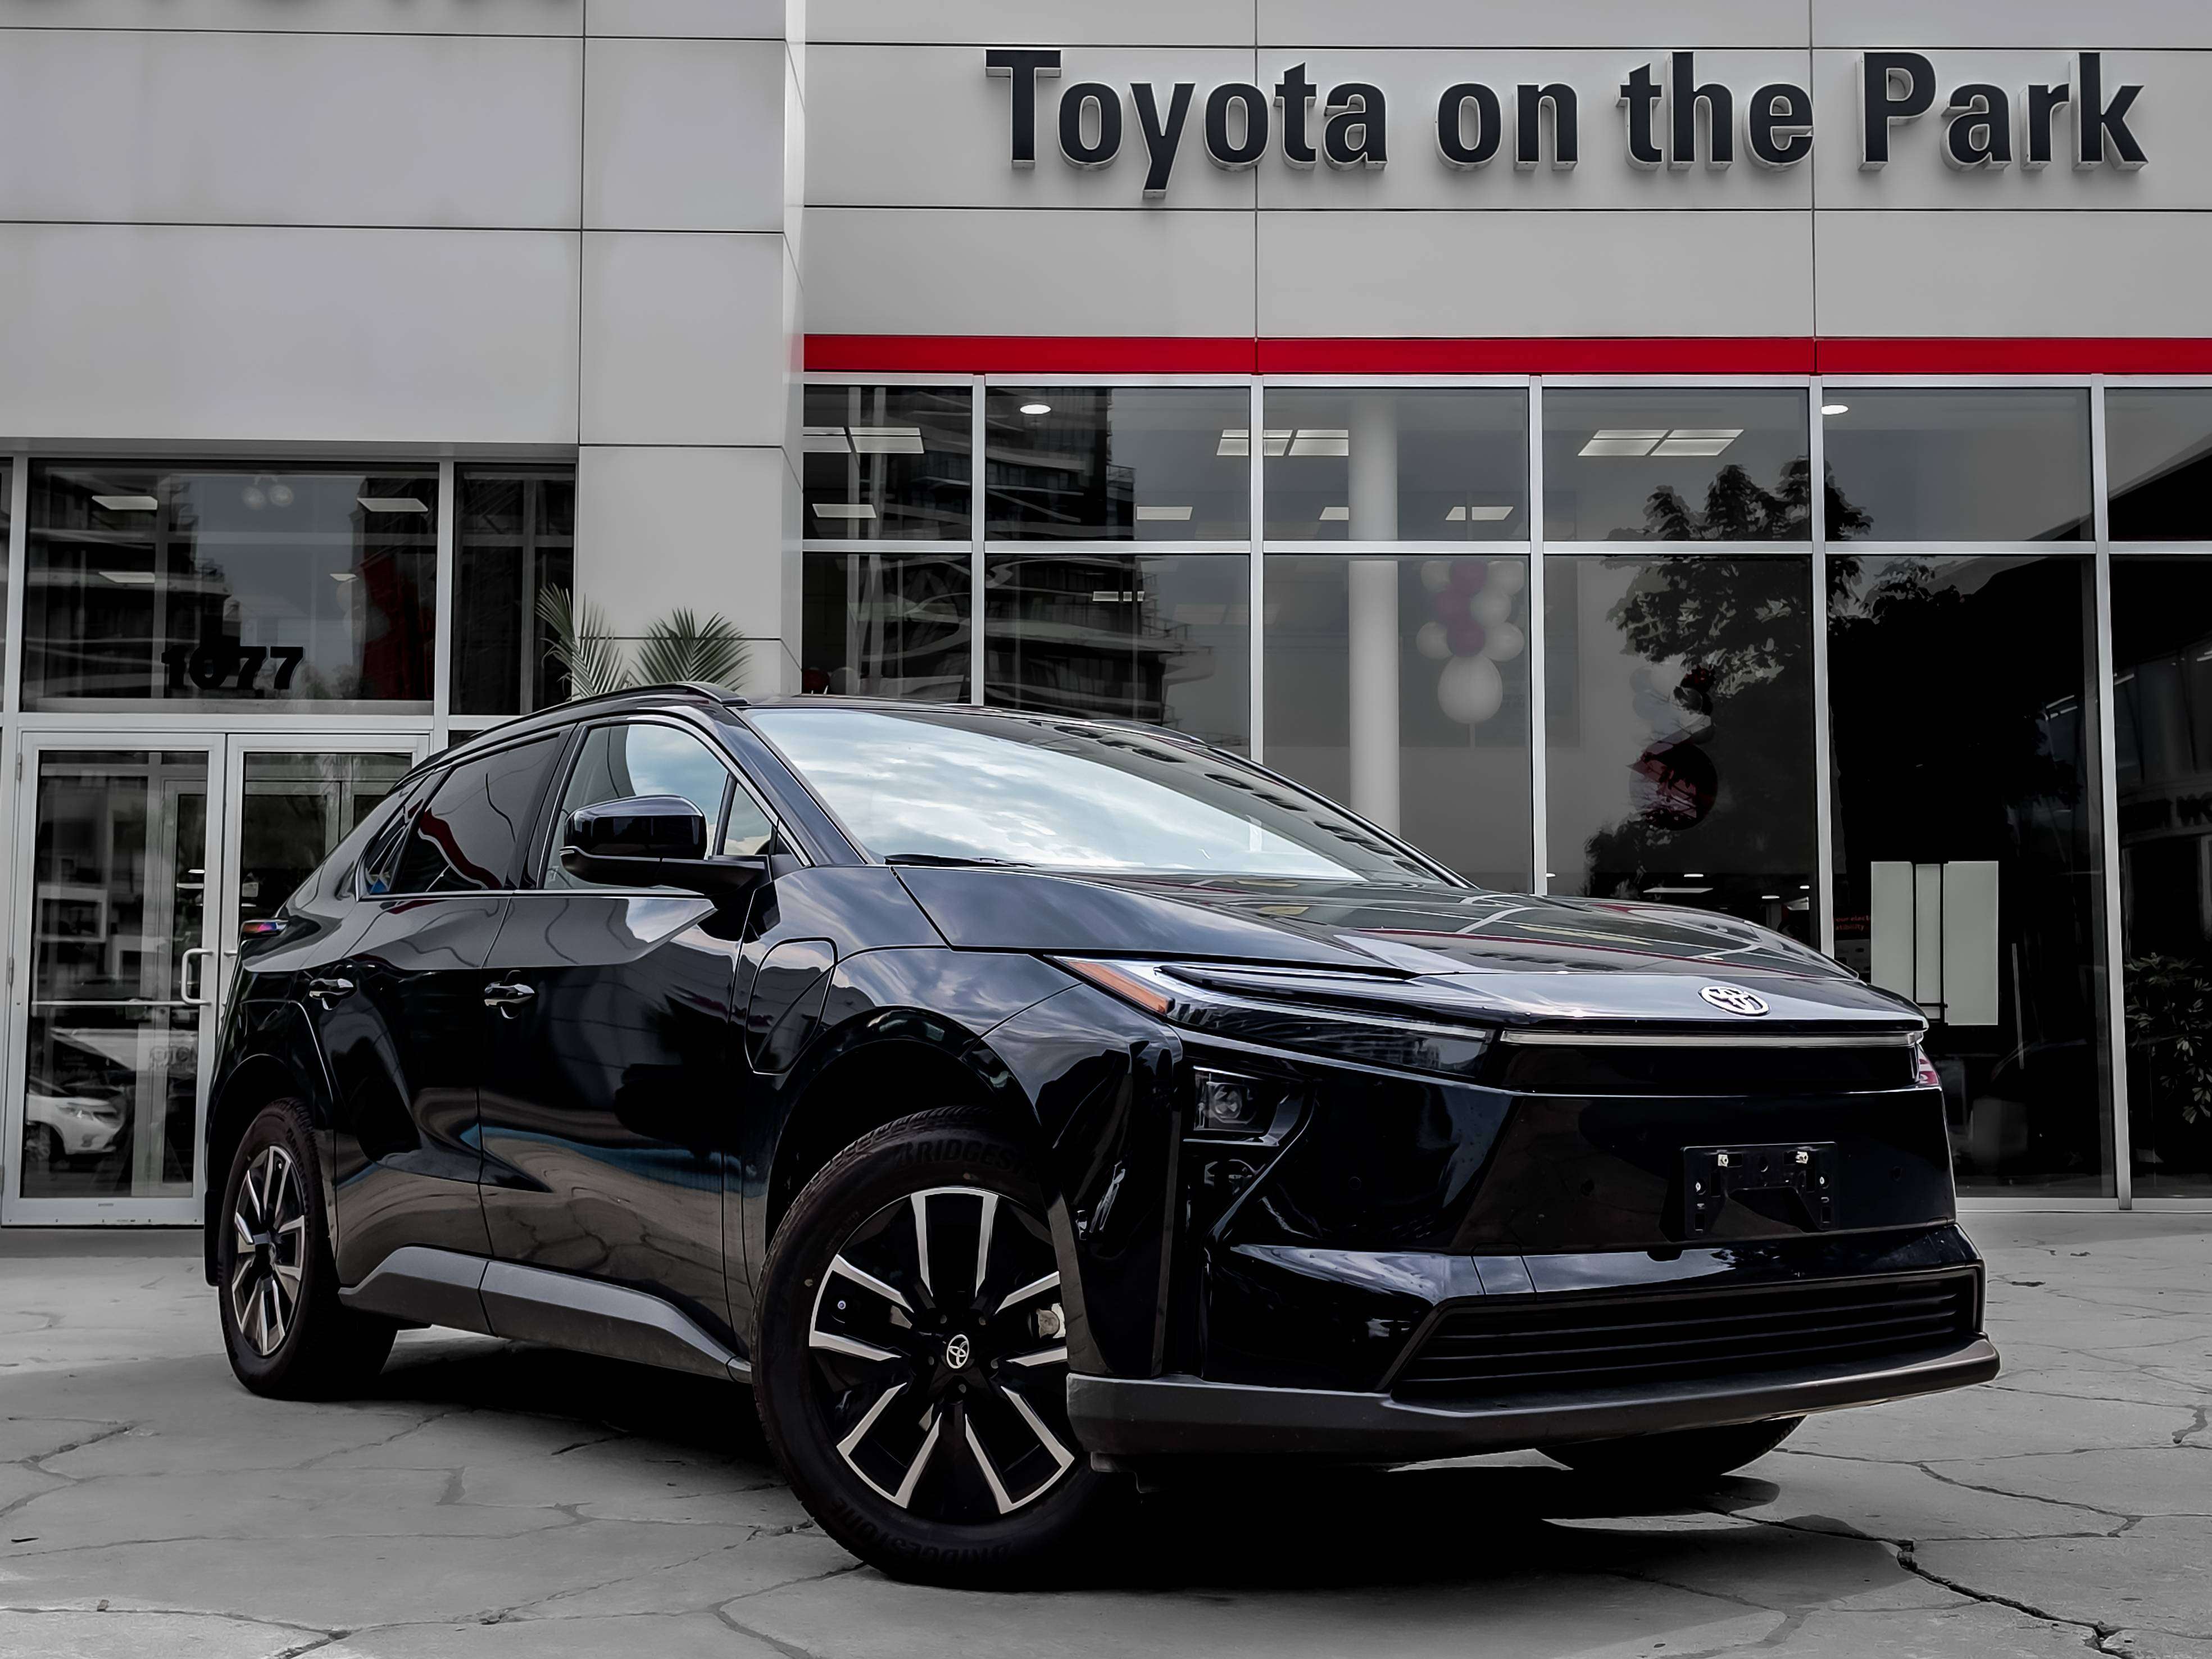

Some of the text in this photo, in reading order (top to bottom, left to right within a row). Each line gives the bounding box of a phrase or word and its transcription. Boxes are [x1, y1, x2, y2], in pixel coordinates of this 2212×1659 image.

[984, 48, 2149, 198] Toyota on the Park
